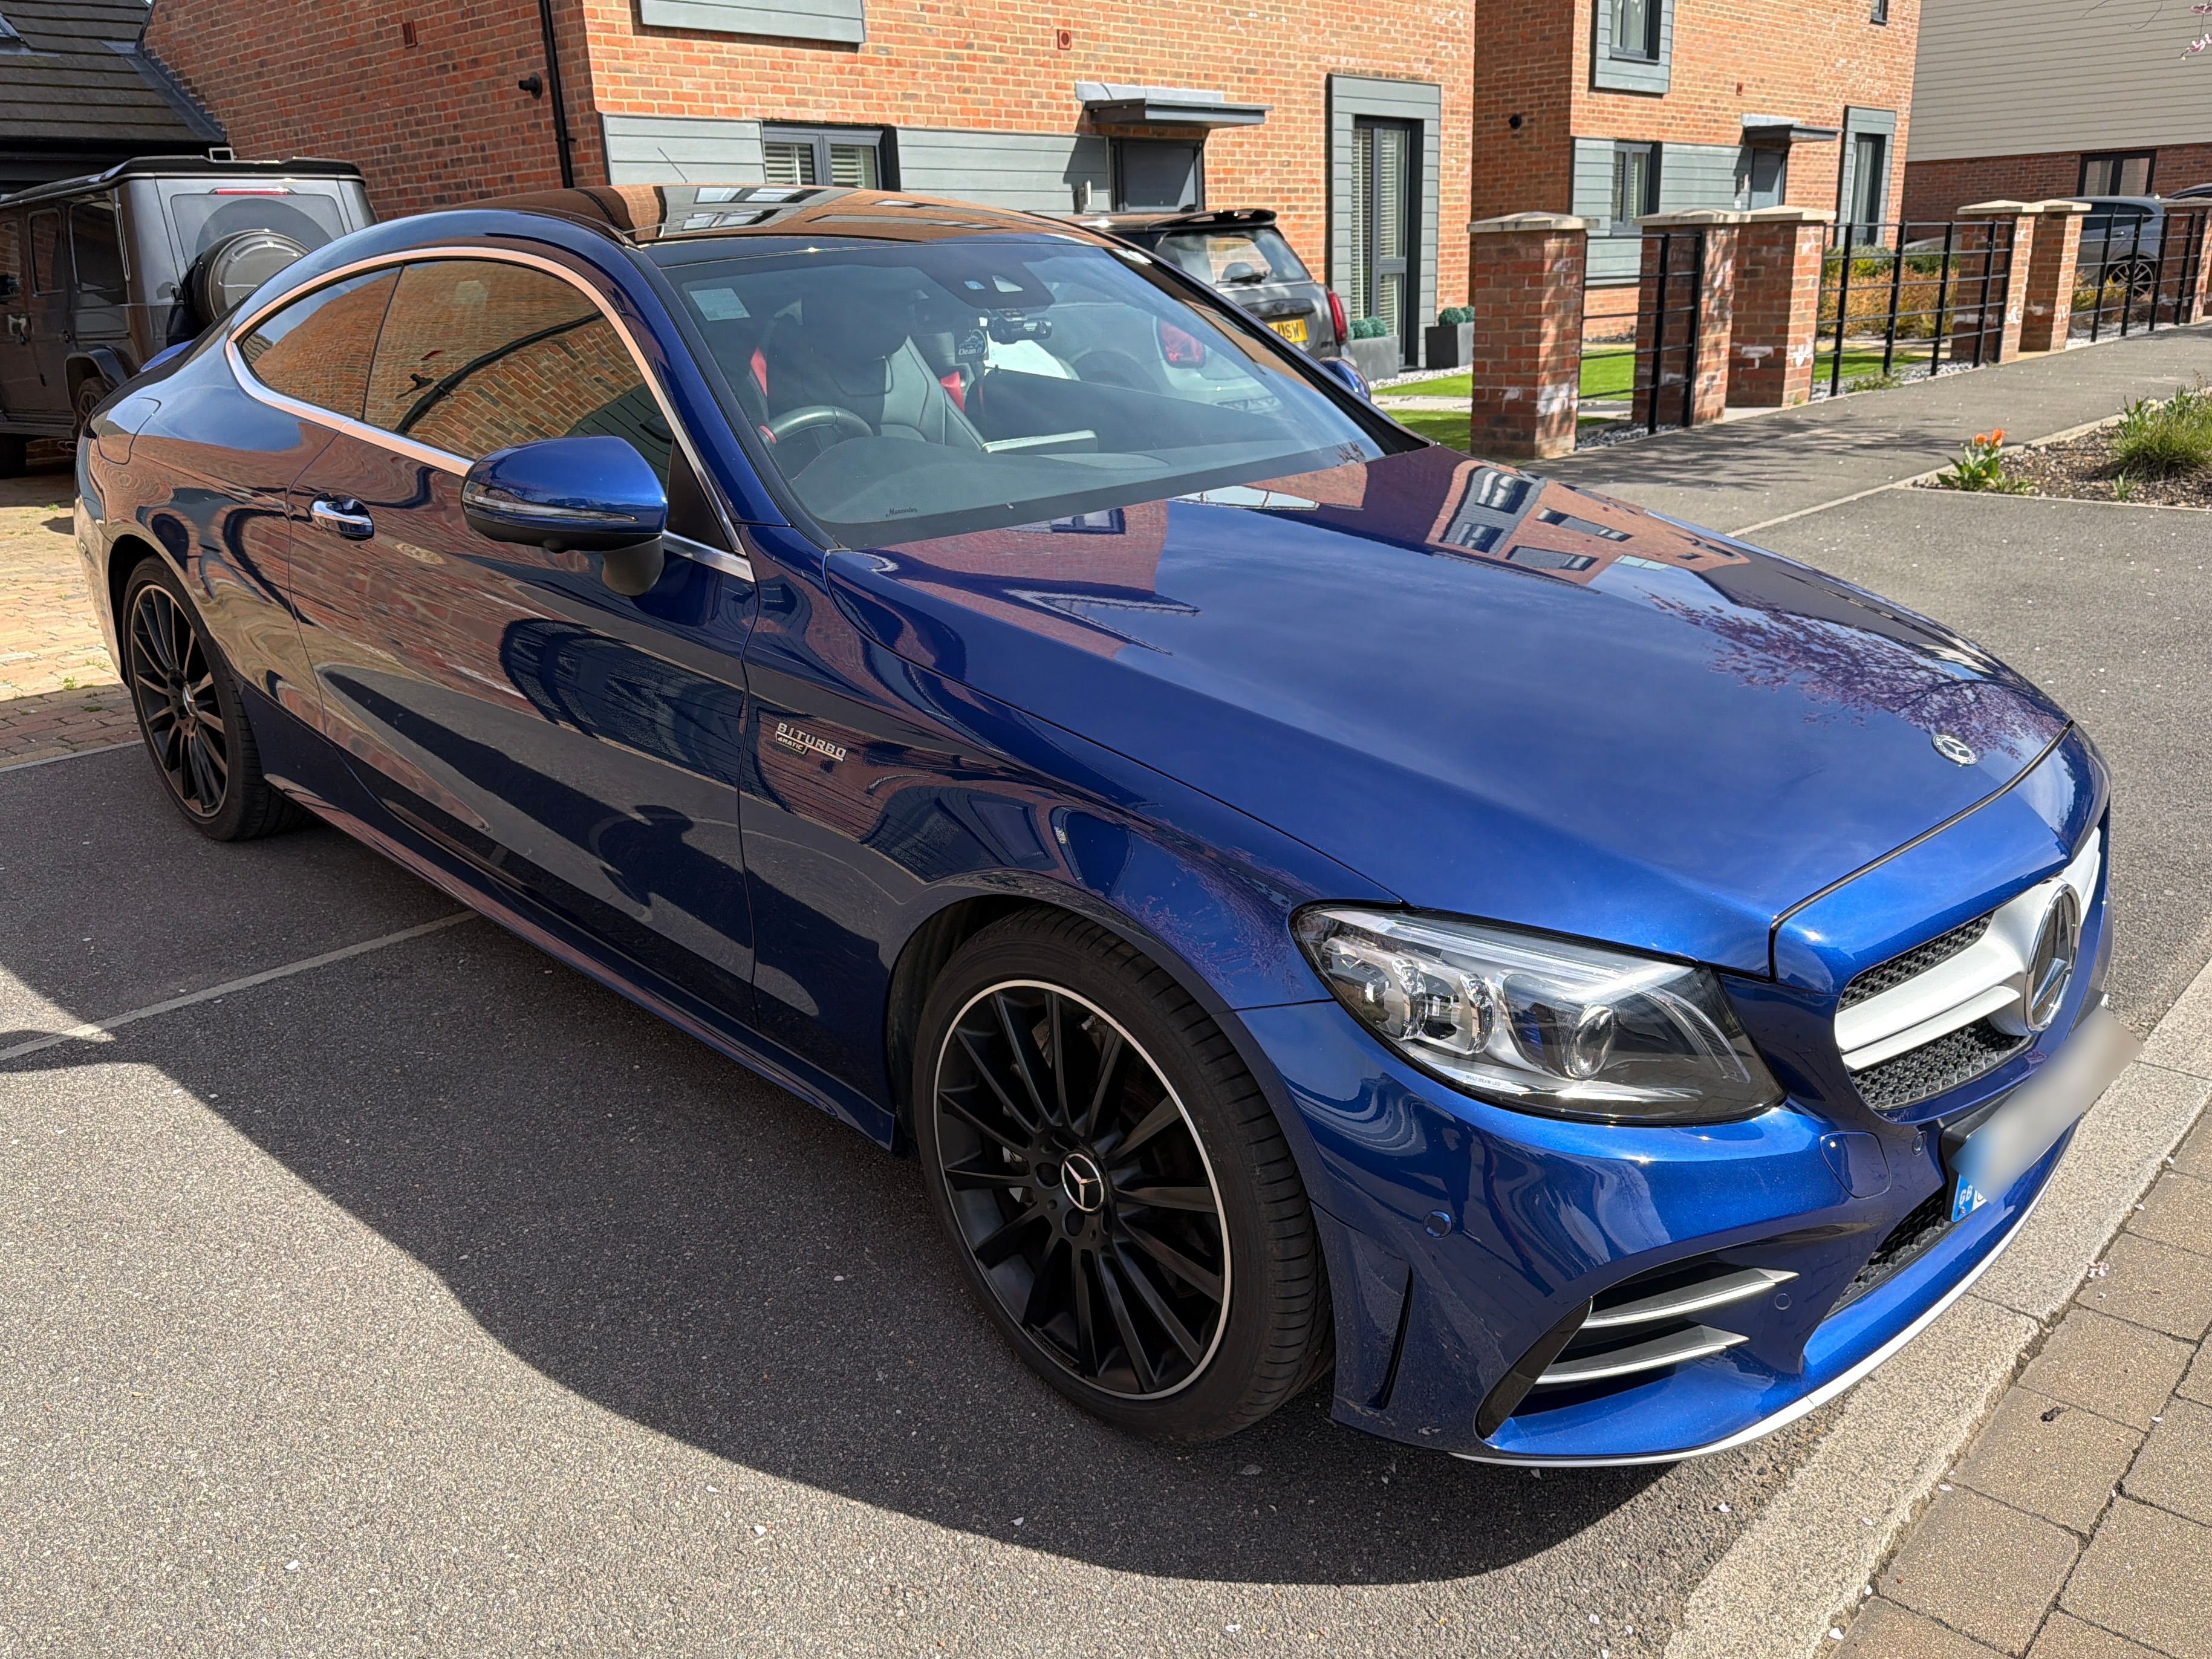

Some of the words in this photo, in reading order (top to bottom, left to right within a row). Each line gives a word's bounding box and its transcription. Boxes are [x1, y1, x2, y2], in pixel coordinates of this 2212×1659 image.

[777, 722, 847, 758] BITURBO
[777, 736, 804, 750] 4MATIC
[1959, 1184, 1974, 1206] GB
